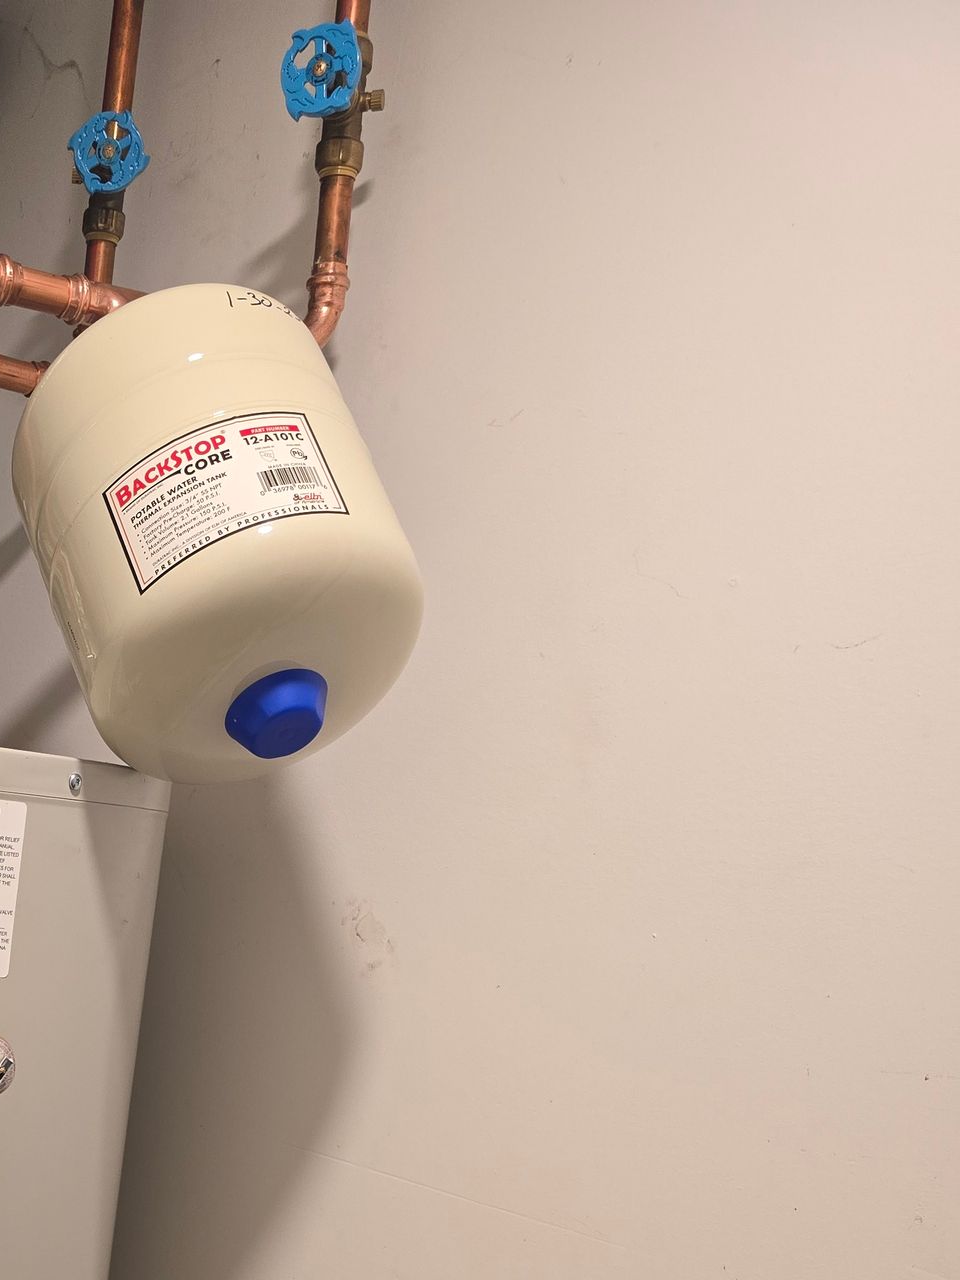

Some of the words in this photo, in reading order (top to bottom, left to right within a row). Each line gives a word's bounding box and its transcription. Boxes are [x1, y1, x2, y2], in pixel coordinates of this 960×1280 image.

[244, 433, 304, 445] 12-A101C
[115, 434, 226, 507] BACKSTOP
[184, 449, 233, 476] CORE
[131, 494, 165, 524] POTABLE
[167, 476, 198, 496] WATER
[133, 506, 162, 530] THERMAL
[164, 481, 205, 507] EXPANSION
[207, 472, 227, 484] TANK
[141, 511, 170, 534] Connection
[171, 504, 184, 514] Size:
[144, 523, 162, 540] Factory
[145, 535, 157, 545] Tank
[159, 521, 180, 535] Volume:
[191, 502, 213, 514] Gallons
[148, 531, 173, 551] Maximum
[174, 517, 199, 532] Pressure:
[150, 537, 176, 557] Maximum
[176, 516, 213, 537] Temperature:
[155, 535, 211, 575] PREFERRED
[217, 526, 230, 536] BY
[237, 504, 329, 527] PROFESSIONALS
